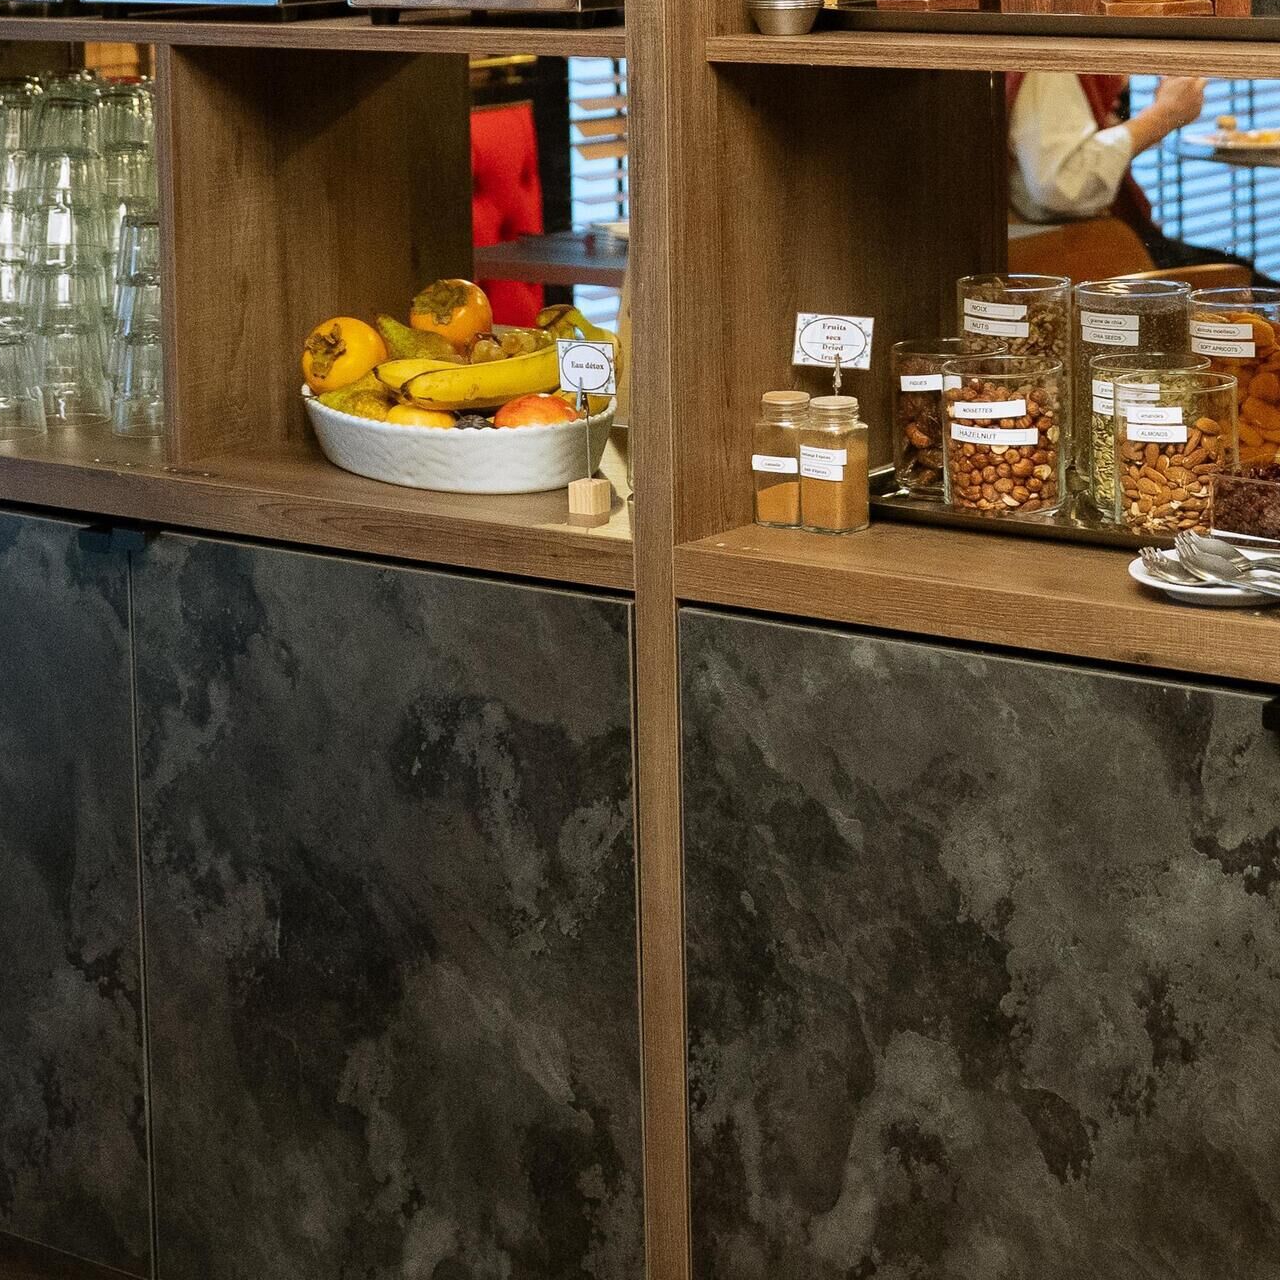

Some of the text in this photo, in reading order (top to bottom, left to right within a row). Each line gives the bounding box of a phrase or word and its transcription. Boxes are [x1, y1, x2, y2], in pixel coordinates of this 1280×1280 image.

[971, 304, 988, 312] NOIX
[822, 323, 847, 331] Fruits
[972, 322, 990, 330] NUTS
[822, 343, 844, 351] Dried
[570, 360, 605, 370] Eau détox
[959, 429, 997, 440] HAZELNUT
